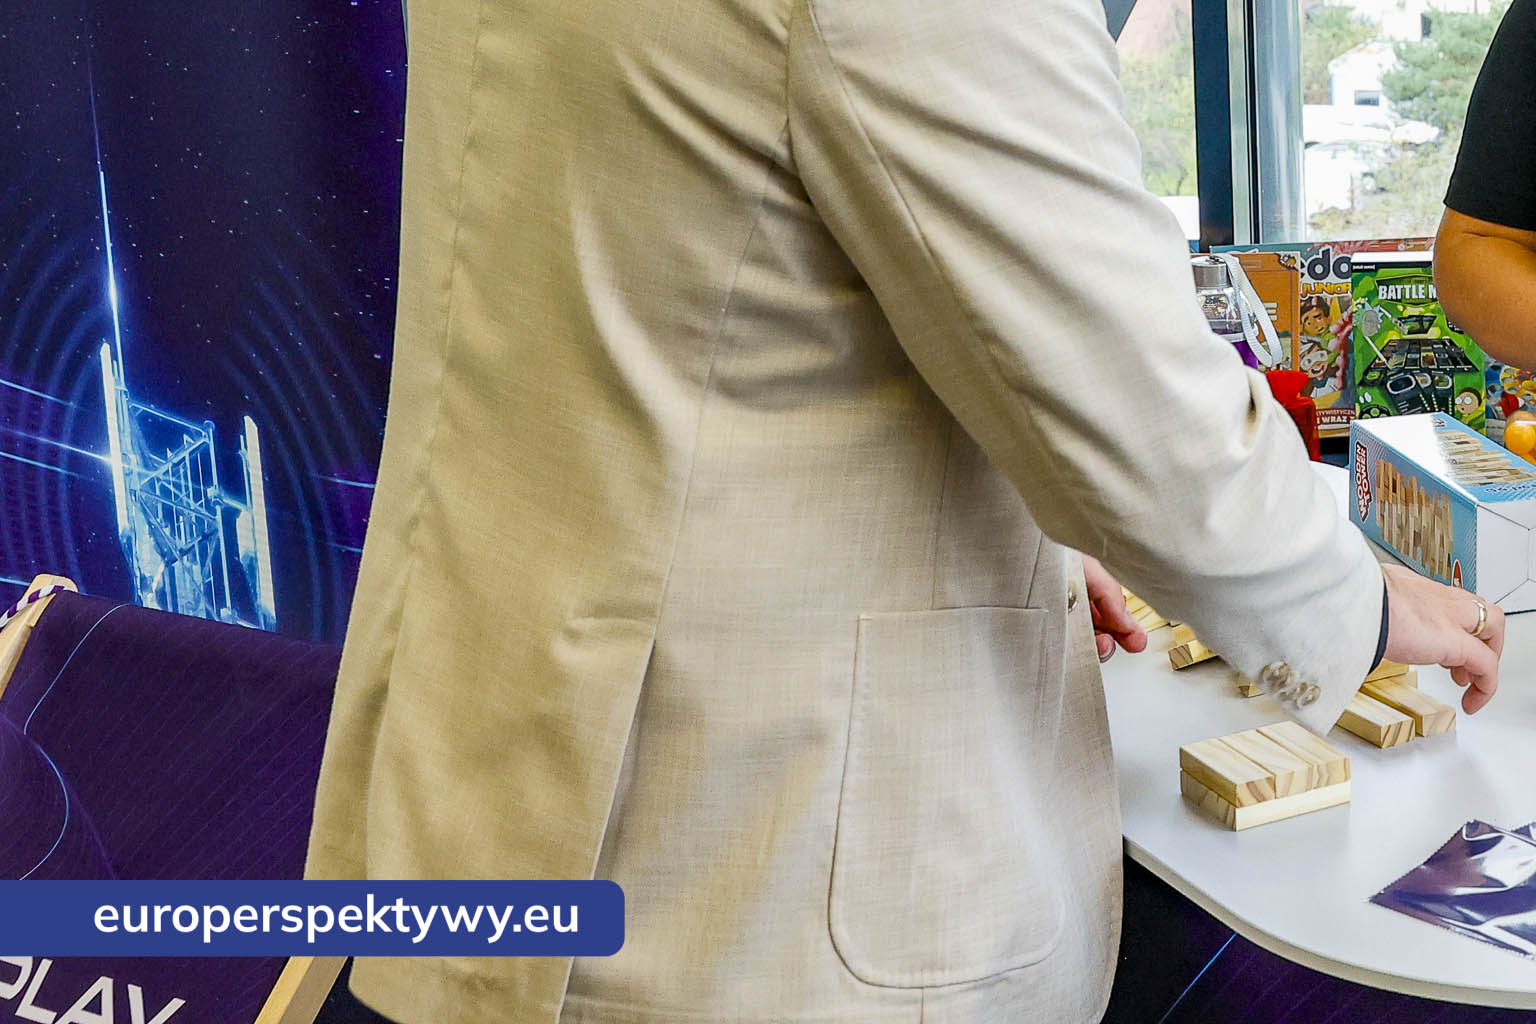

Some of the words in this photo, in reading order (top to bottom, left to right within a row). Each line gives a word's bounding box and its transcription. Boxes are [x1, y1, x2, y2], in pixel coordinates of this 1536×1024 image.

[1378, 284, 1426, 300] BATTLE
[1355, 444, 1367, 518] WOODEN
[1360, 447, 1372, 507] TOWER
